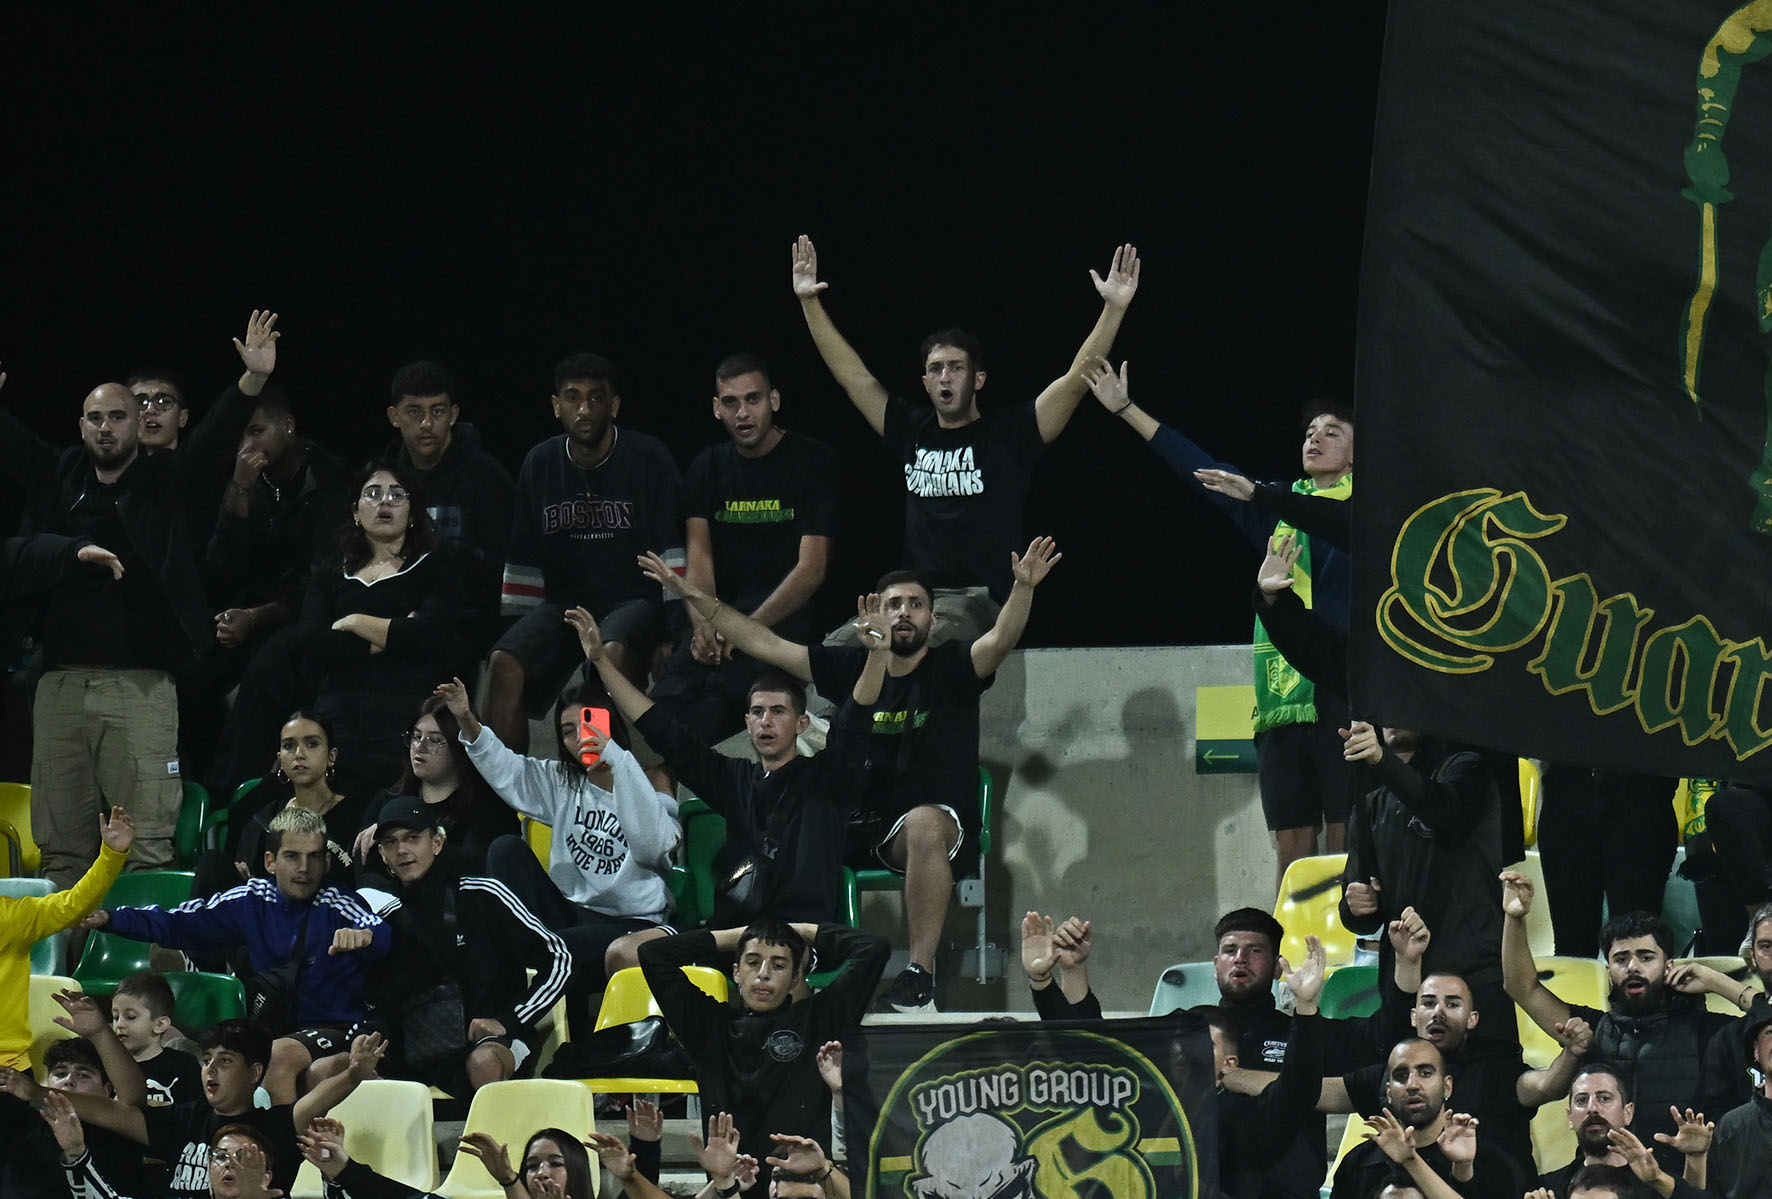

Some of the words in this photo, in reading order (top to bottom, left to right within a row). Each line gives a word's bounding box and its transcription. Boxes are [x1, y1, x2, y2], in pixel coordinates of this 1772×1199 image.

[544, 500, 635, 535] BOSTON
[725, 499, 782, 512] LARNAKA
[566, 834, 596, 870] HYDE
[581, 830, 614, 857] 1986
[917, 1074, 1019, 1126] YOUNG
[1028, 1070, 1131, 1109] GROUP
